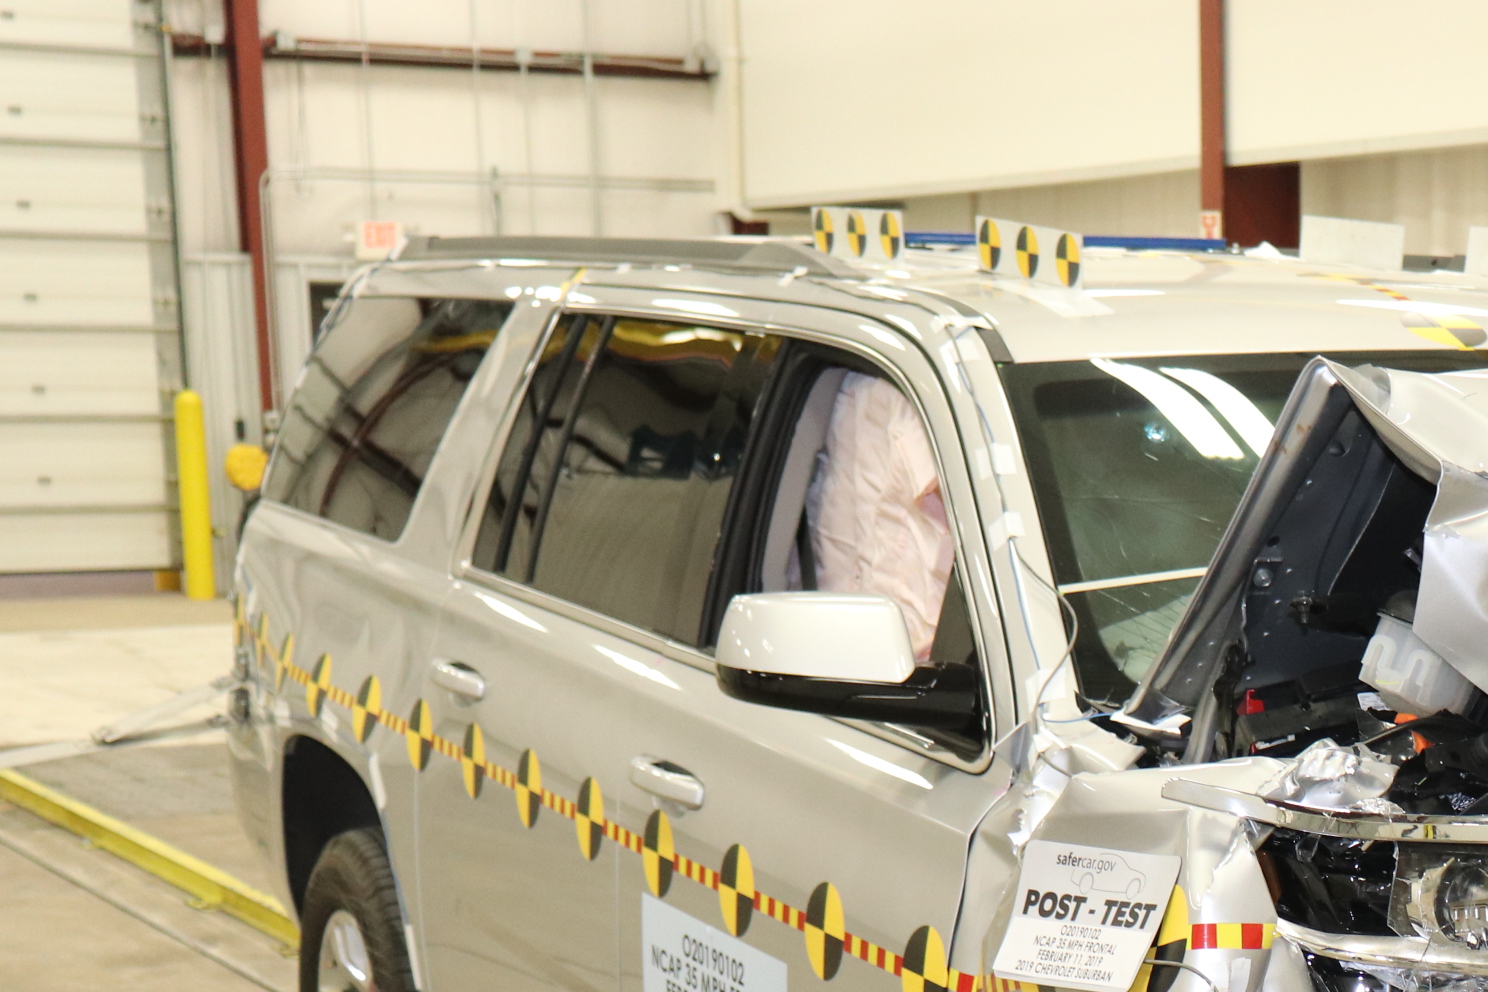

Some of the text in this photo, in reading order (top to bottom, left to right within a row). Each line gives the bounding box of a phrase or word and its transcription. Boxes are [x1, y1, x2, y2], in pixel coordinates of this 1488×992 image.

[1056, 852, 1117, 874] safercar.gov
[1022, 888, 1088, 922] POST
[1101, 899, 1158, 930] TEST
[1033, 935, 1117, 955] NCAP 35 MPH FRONTAL
[651, 944, 682, 980] NCAP
[685, 963, 698, 990] 35
[1036, 949, 1074, 964] FEBRUARY
[1084, 955, 1104, 968] 2019
[1014, 959, 1114, 982] 2019 CHEVROLET SUBURBAN
